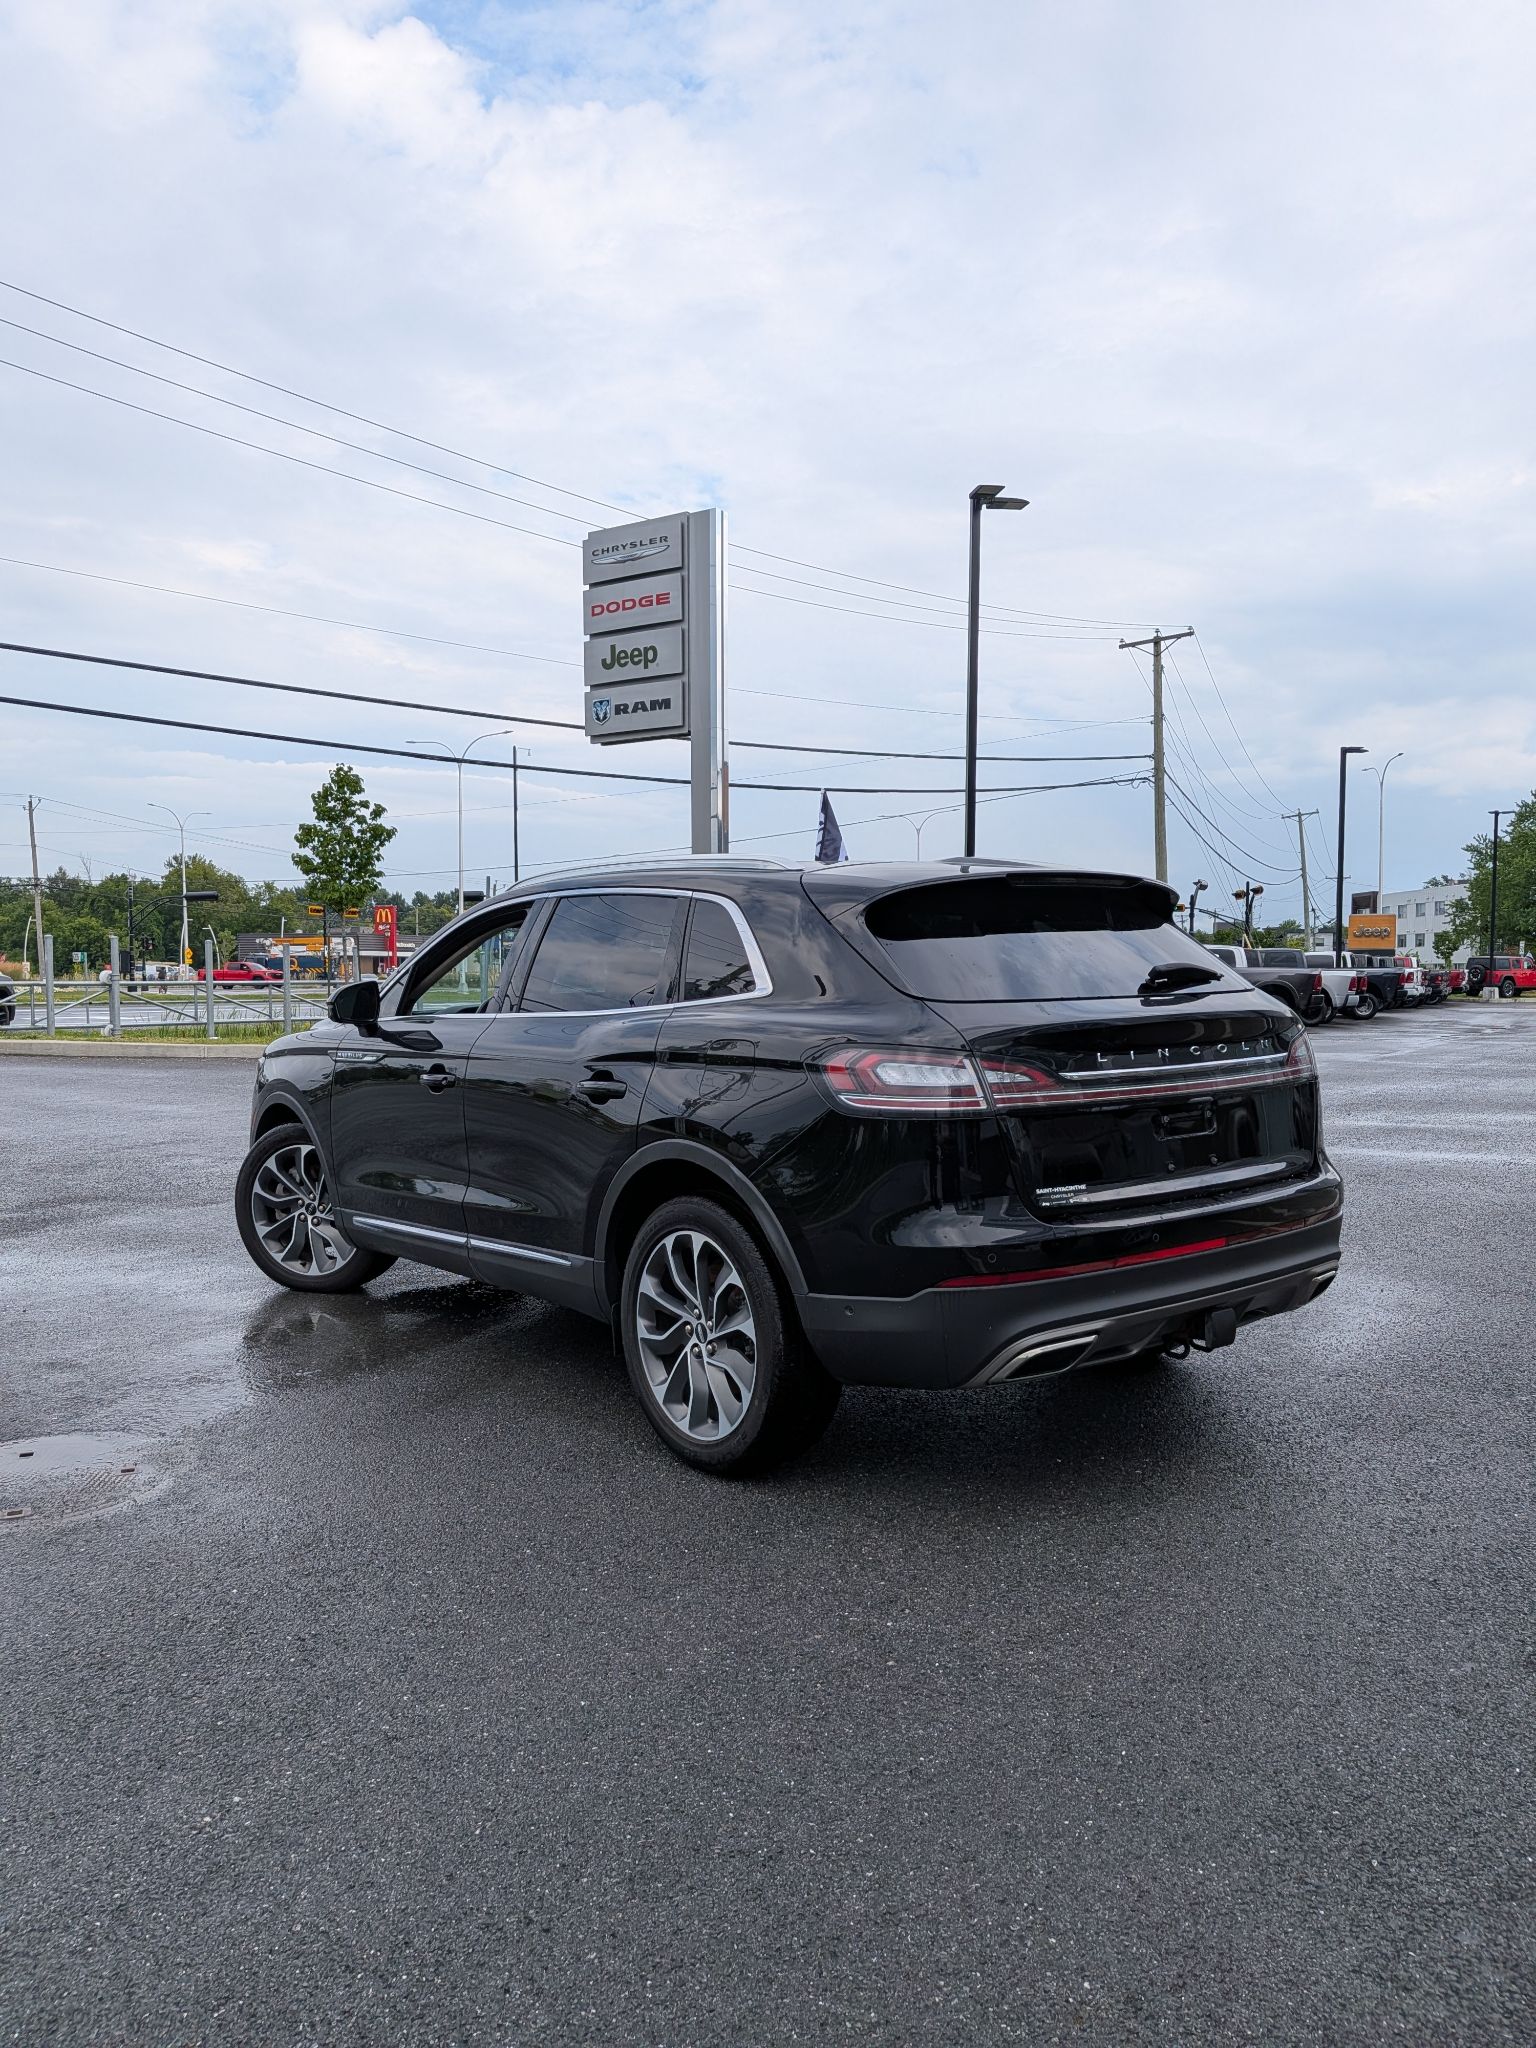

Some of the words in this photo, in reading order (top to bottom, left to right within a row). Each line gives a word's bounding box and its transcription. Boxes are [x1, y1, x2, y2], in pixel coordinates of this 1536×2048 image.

[591, 535, 670, 557] CHRYSLER
[590, 591, 671, 618] DODGE
[600, 643, 658, 671] Jeep
[614, 697, 672, 716] RAM
[1353, 924, 1391, 939] Jeep
[1097, 1039, 1268, 1062] LINCOLN
[1035, 1184, 1088, 1195] SAINT-HYACINTHE
